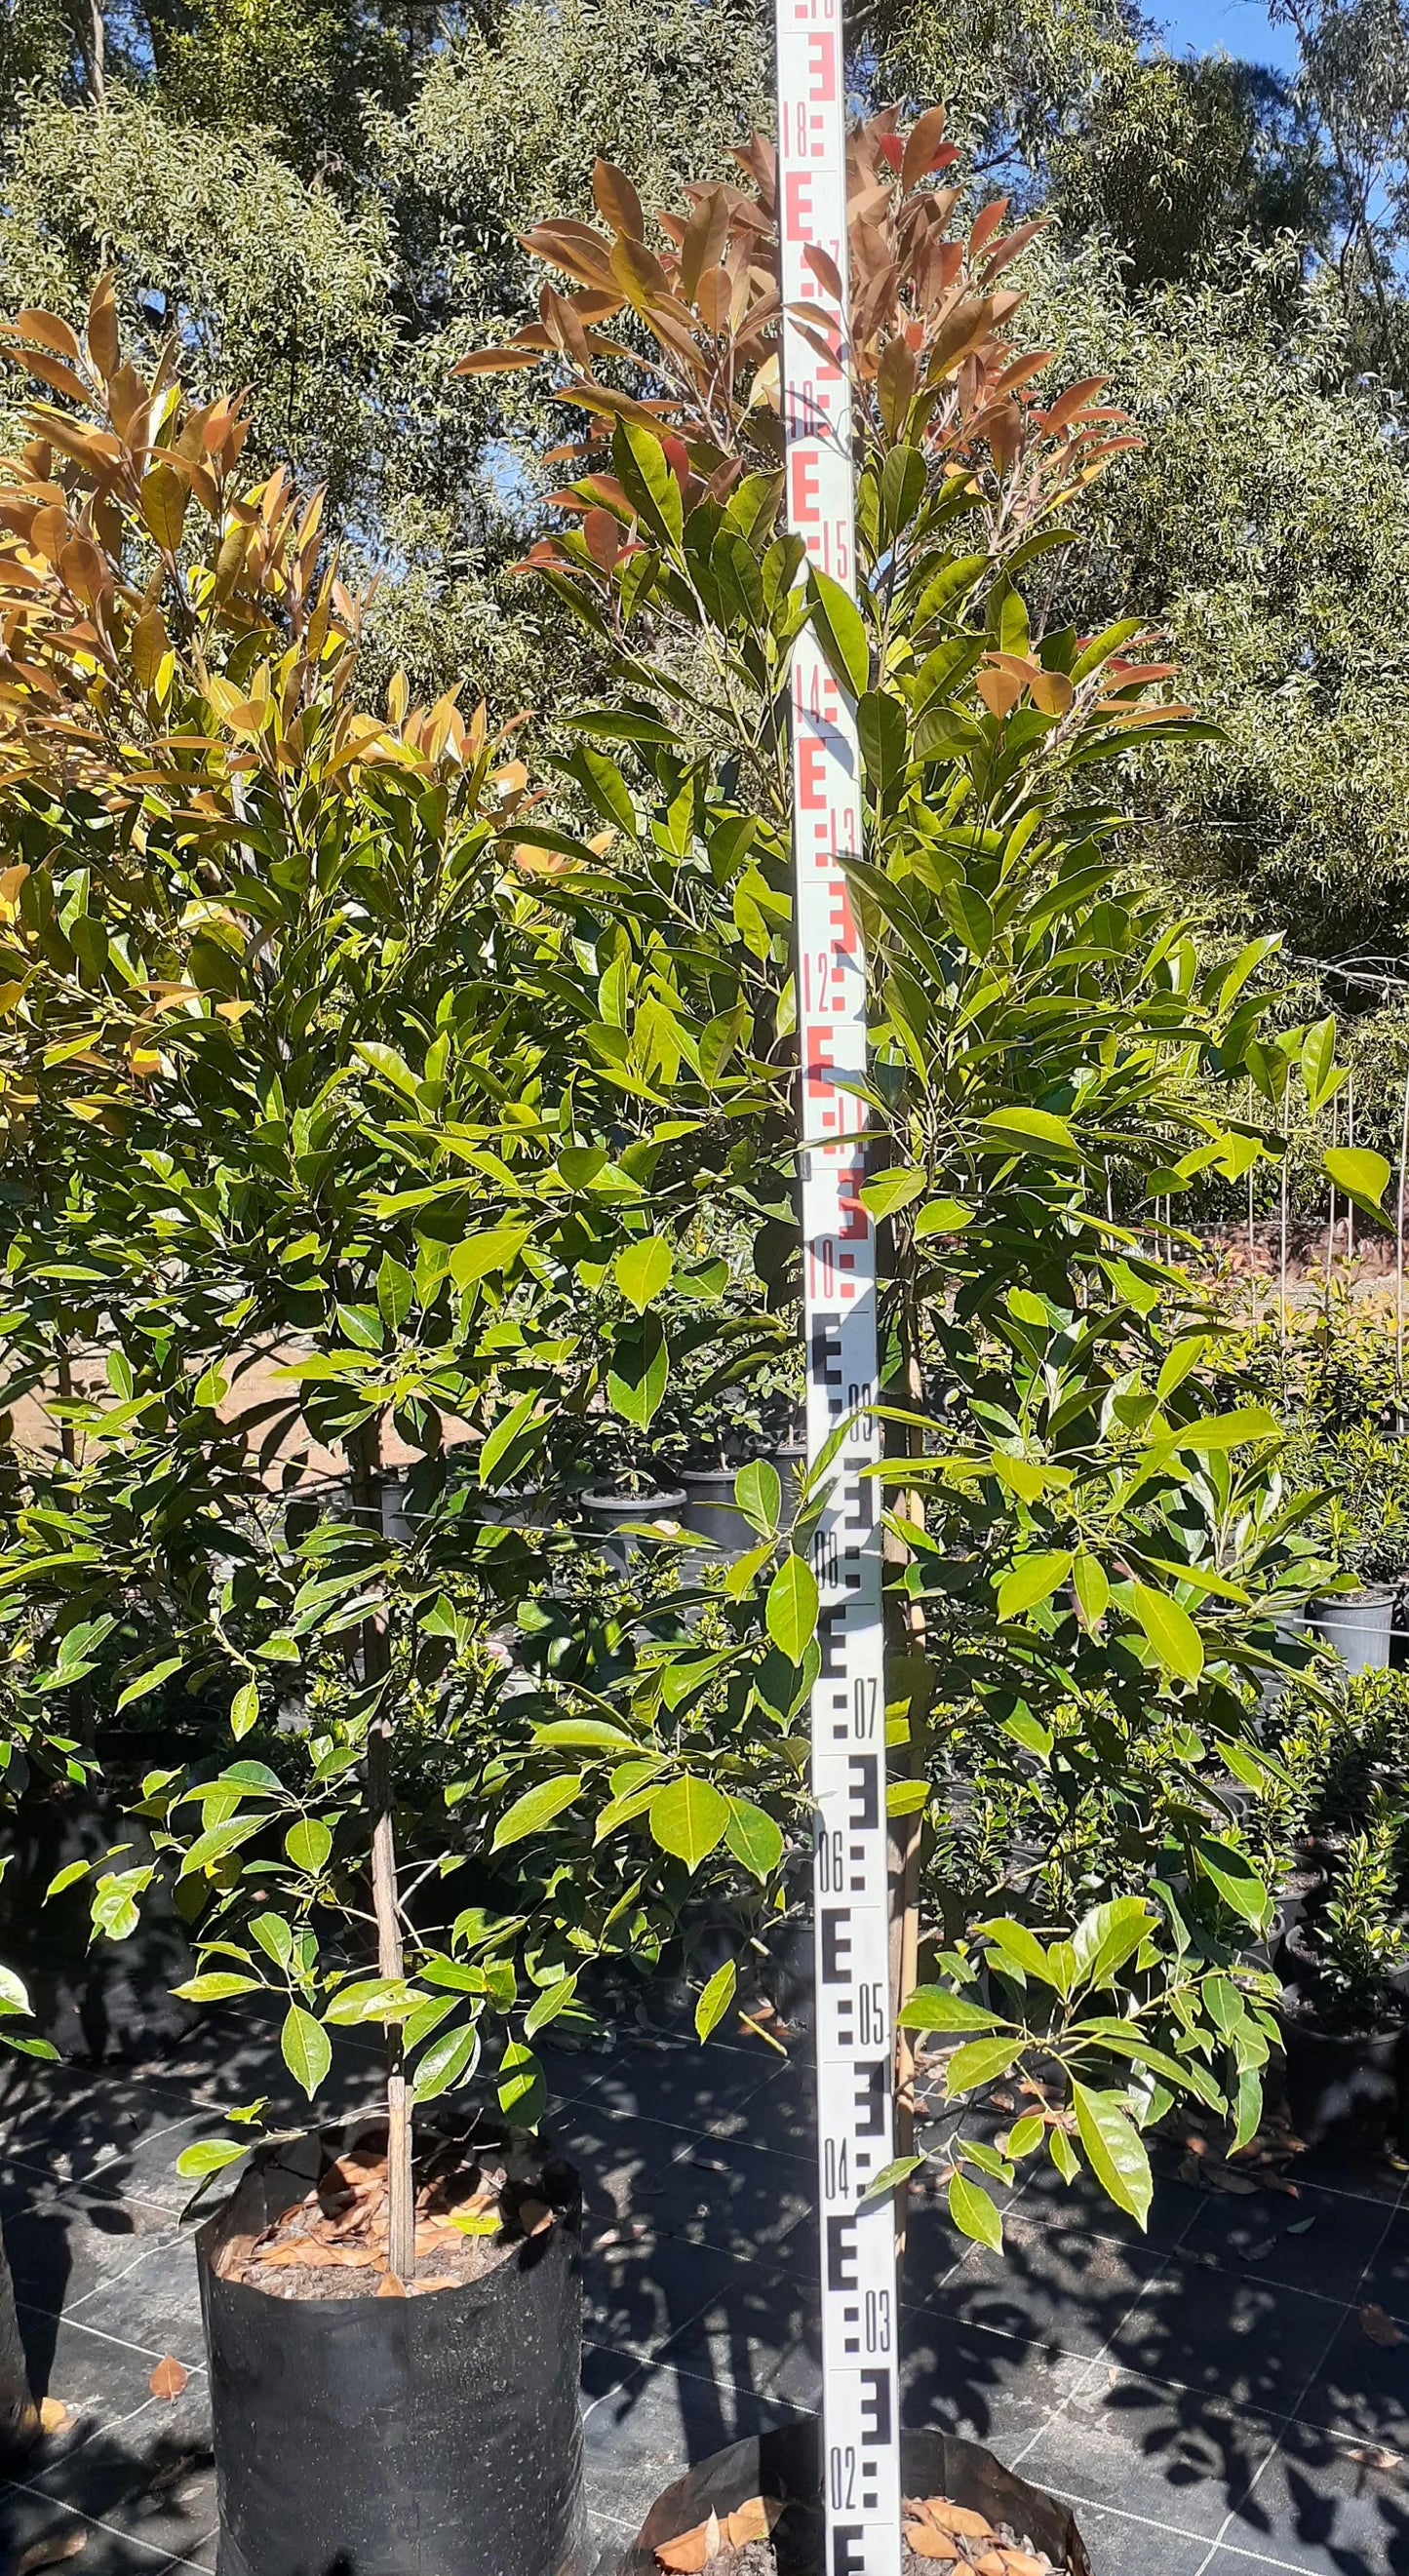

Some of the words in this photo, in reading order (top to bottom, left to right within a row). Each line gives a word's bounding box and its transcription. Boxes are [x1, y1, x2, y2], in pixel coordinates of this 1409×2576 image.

[784, 101, 806, 158] 18
[823, 520, 847, 580] 15
[796, 664, 820, 723] 14
[803, 953, 829, 1013] 12
[809, 1239, 834, 1299] 10
[848, 1383, 873, 1443] 09
[814, 1530, 838, 1590] 08
[854, 1677, 878, 1739] 07
[818, 1830, 843, 1893] 06
[859, 1983, 883, 2046] 05
[824, 2137, 849, 2201] 04
[866, 2289, 890, 2353] 03
[830, 2445, 856, 2510] 02
